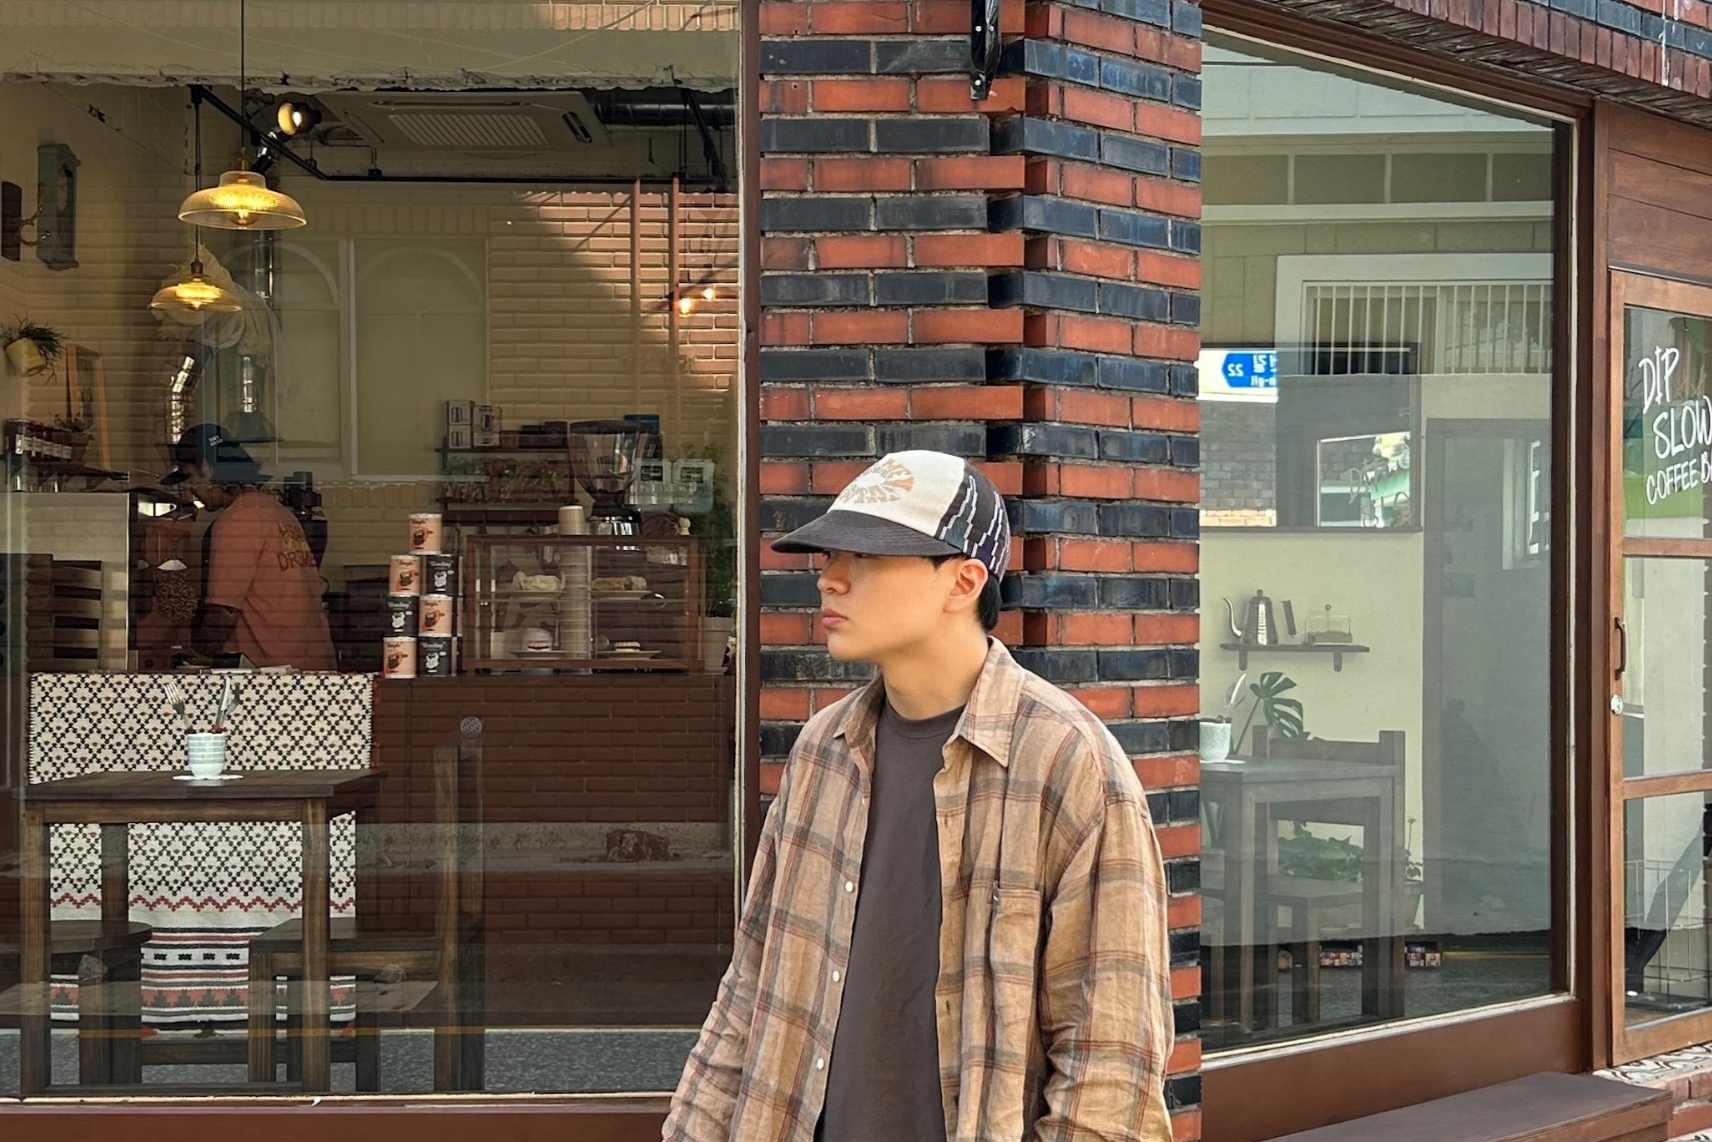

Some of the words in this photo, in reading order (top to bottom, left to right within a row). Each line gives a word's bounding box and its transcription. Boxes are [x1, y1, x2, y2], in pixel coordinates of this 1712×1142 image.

[1638, 346, 1679, 414] DIP
[1653, 395, 1712, 459] SLOW
[1646, 459, 1698, 505] COFFEE
